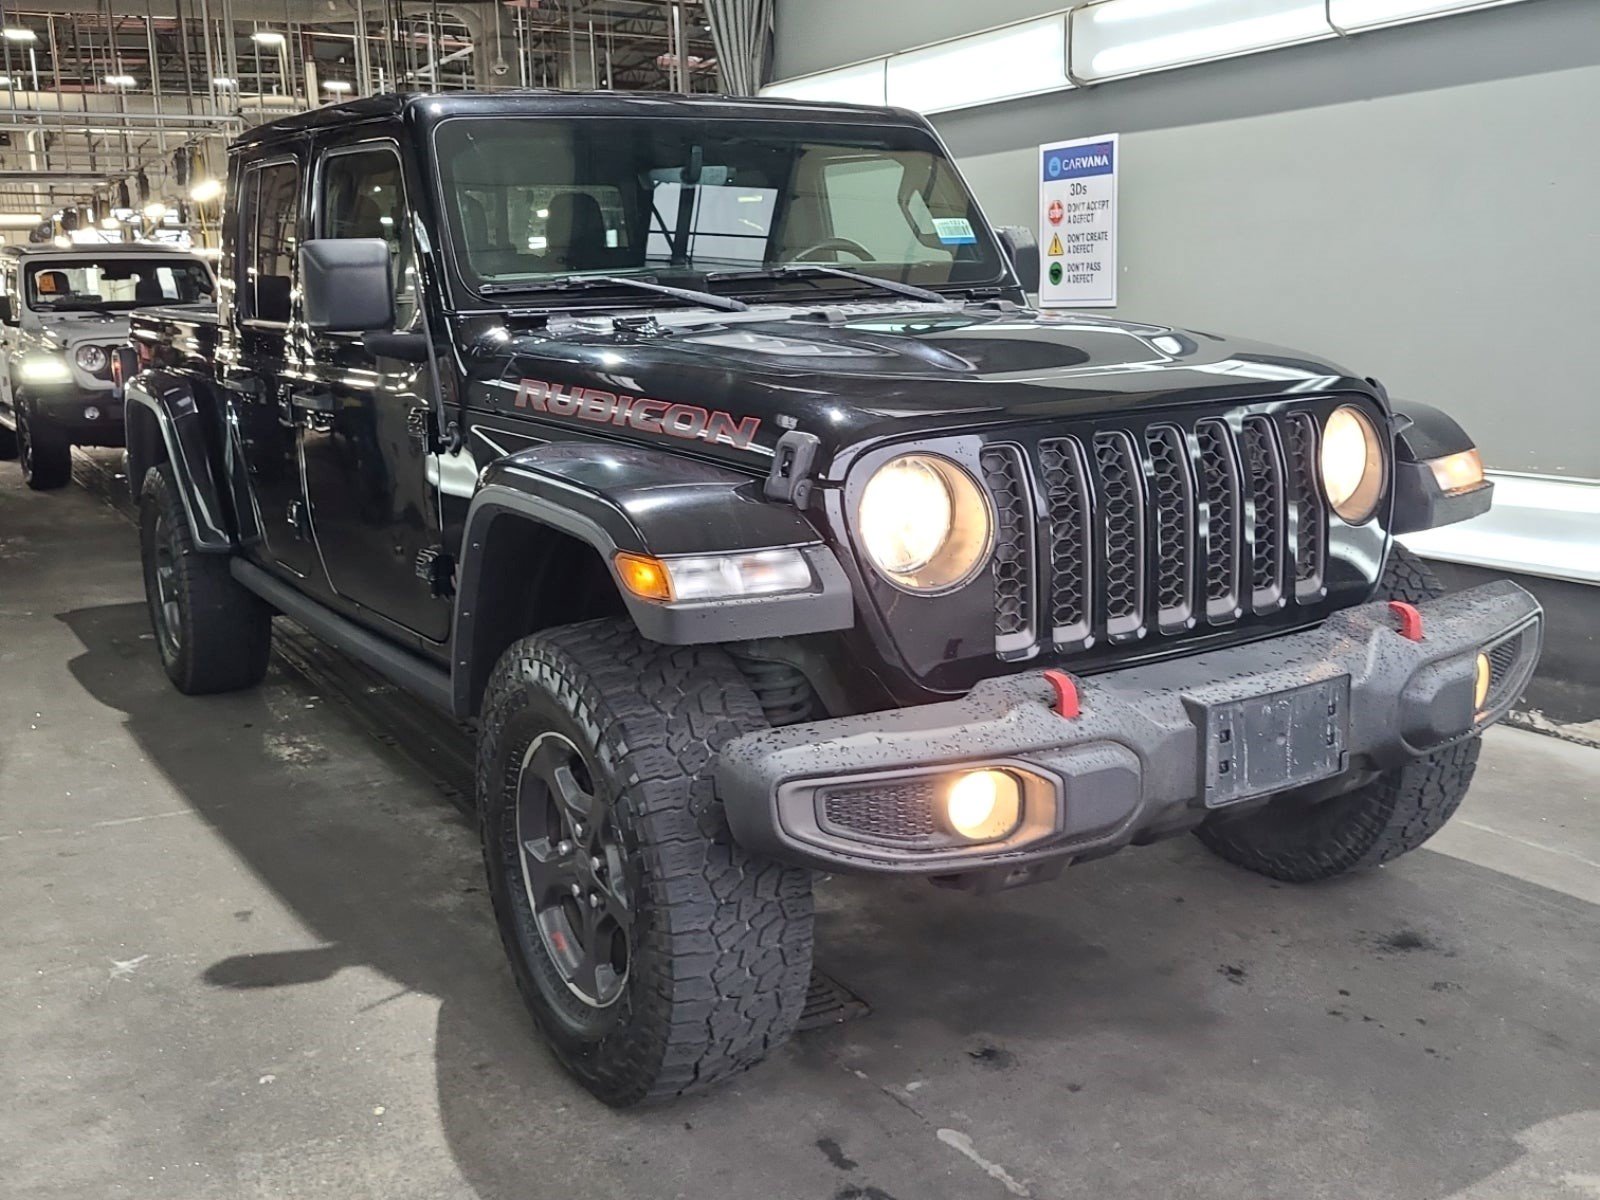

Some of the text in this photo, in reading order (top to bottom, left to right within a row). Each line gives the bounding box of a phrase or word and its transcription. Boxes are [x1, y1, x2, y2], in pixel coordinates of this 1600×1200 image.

[1062, 154, 1109, 171] CARVANA
[1070, 182, 1087, 196] 3Ds
[1086, 200, 1109, 211] ACCEPT
[1067, 214, 1072, 224] A
[1072, 213, 1094, 224] DEFECT
[1067, 231, 1108, 243] DON'T CREATE
[1067, 243, 1094, 254] A DEFECT
[1067, 261, 1101, 272] DON'T PASS
[1067, 273, 1094, 284] A DEFECT
[514, 378, 761, 449] RUBICON
